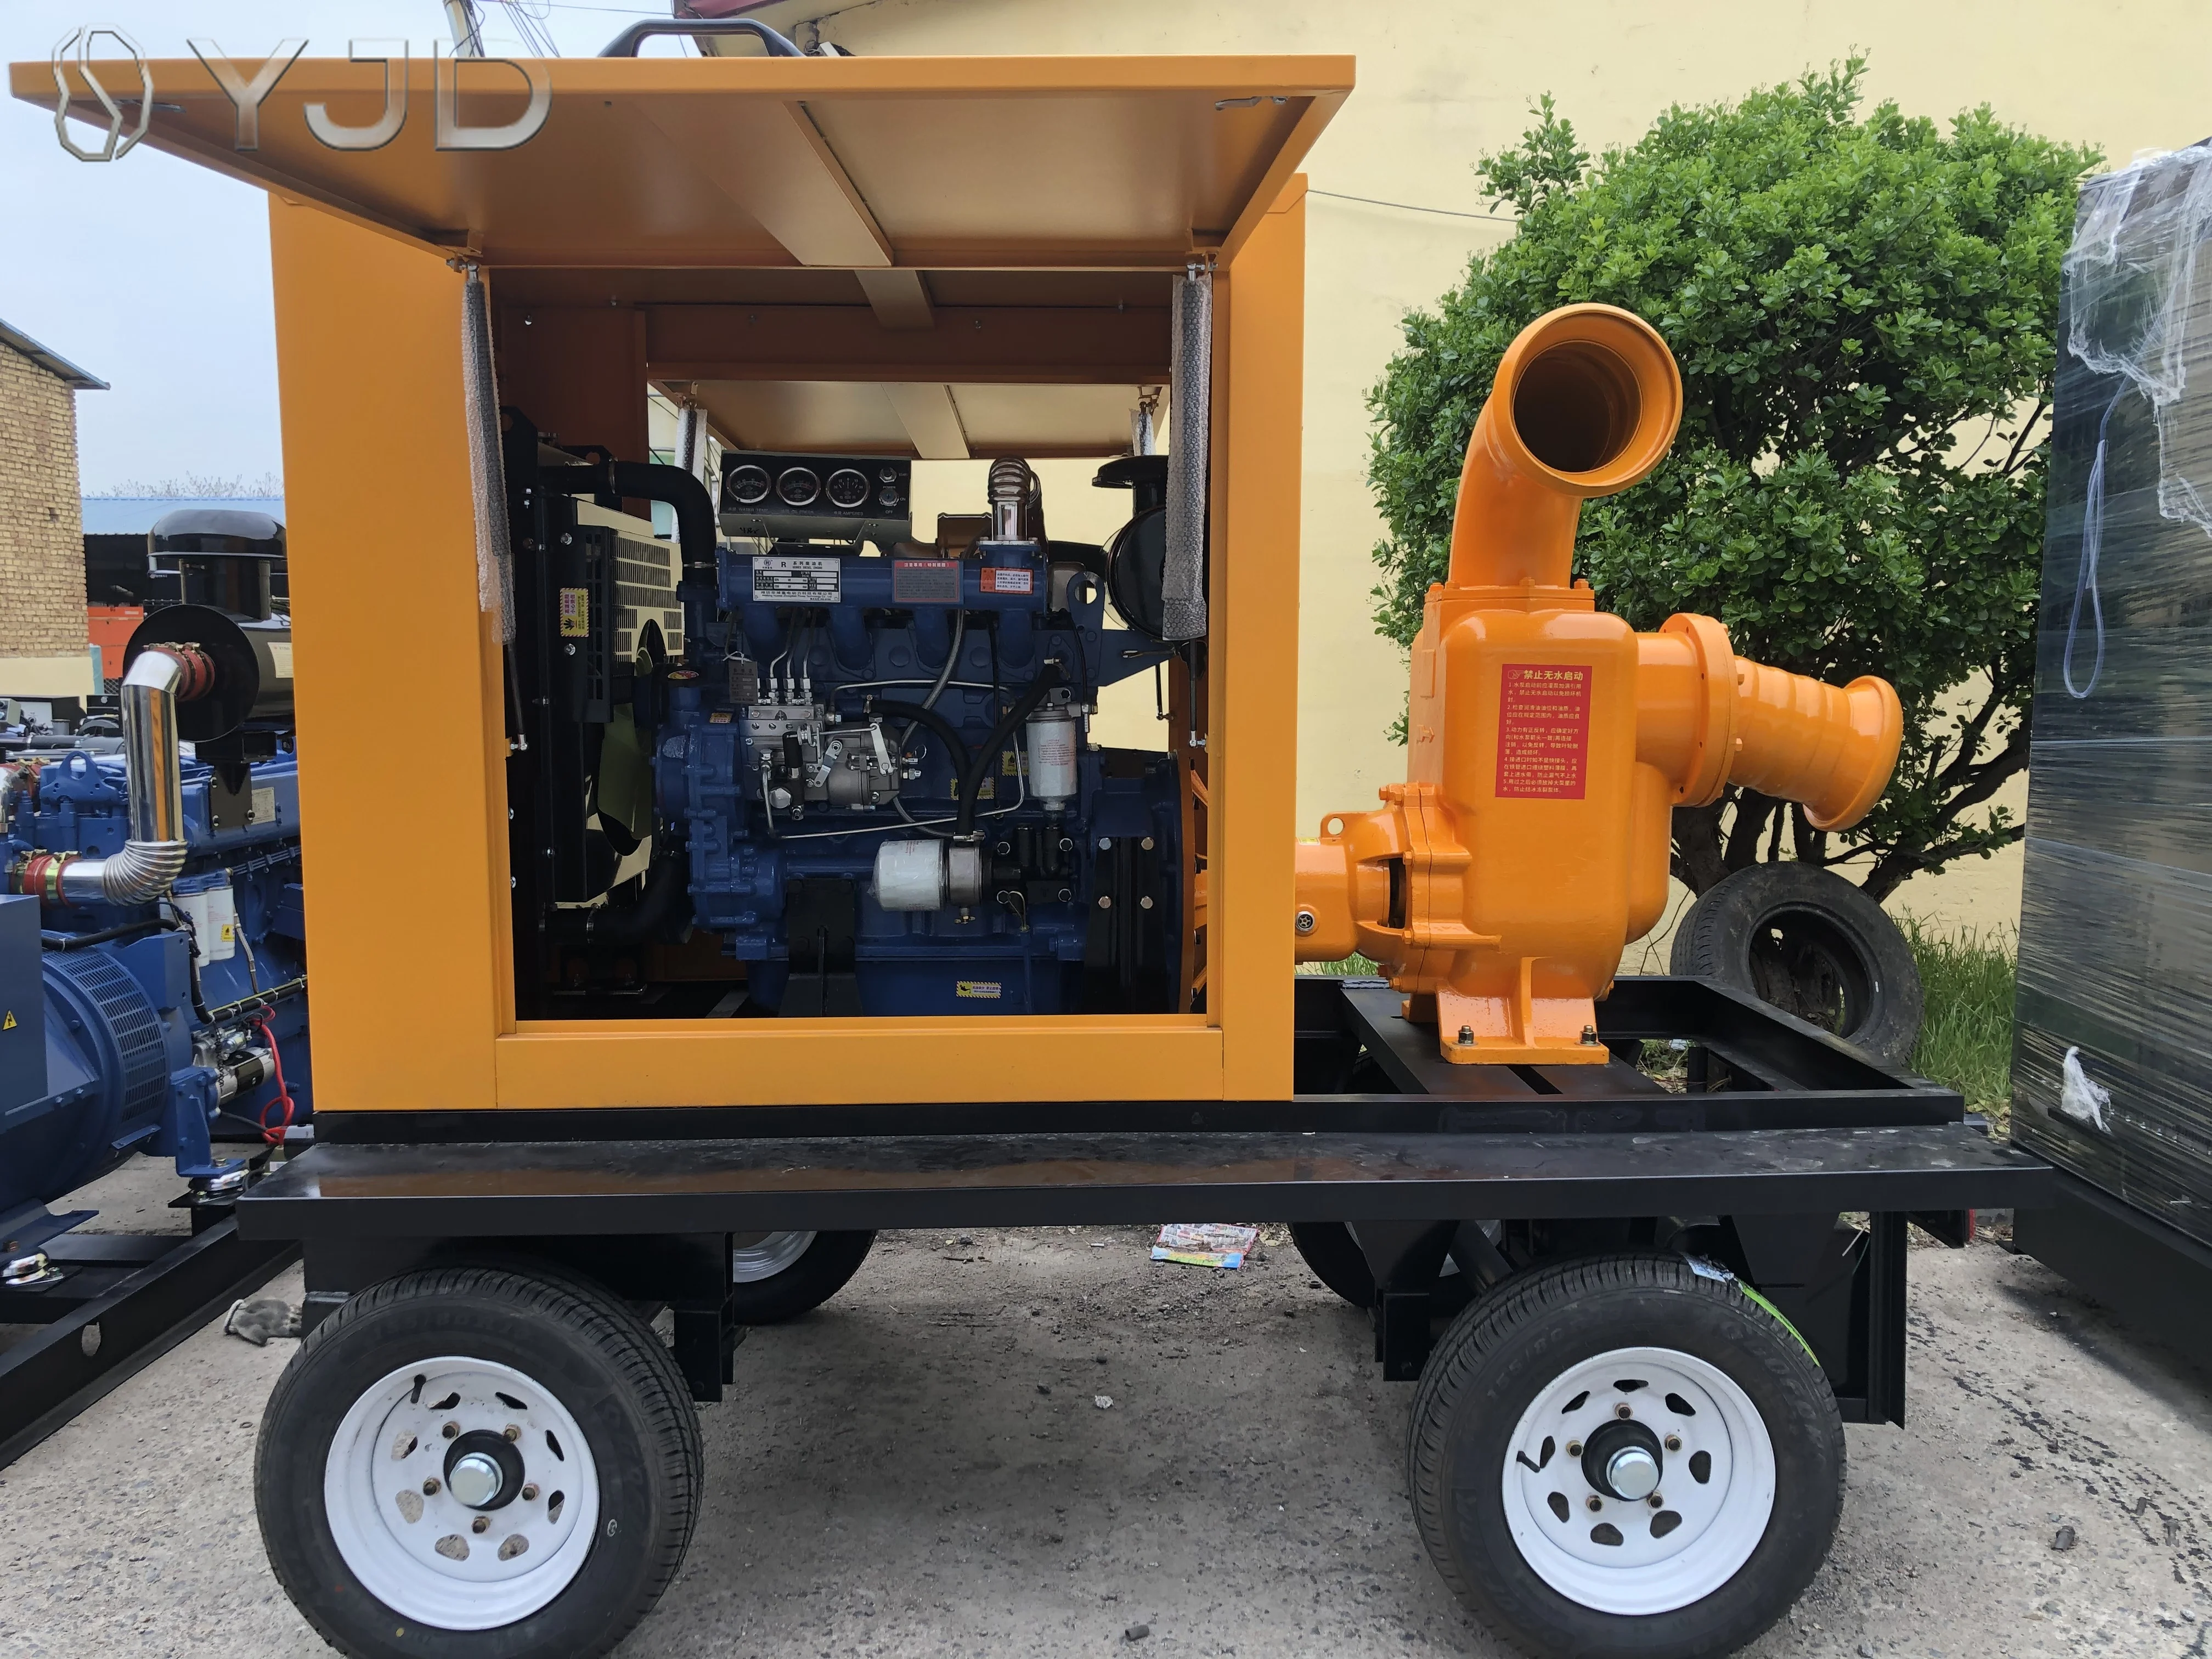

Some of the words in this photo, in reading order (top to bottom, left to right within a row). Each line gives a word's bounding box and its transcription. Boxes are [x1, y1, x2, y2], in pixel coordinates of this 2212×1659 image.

[1523, 669, 1583, 681] 禁止无水启动
